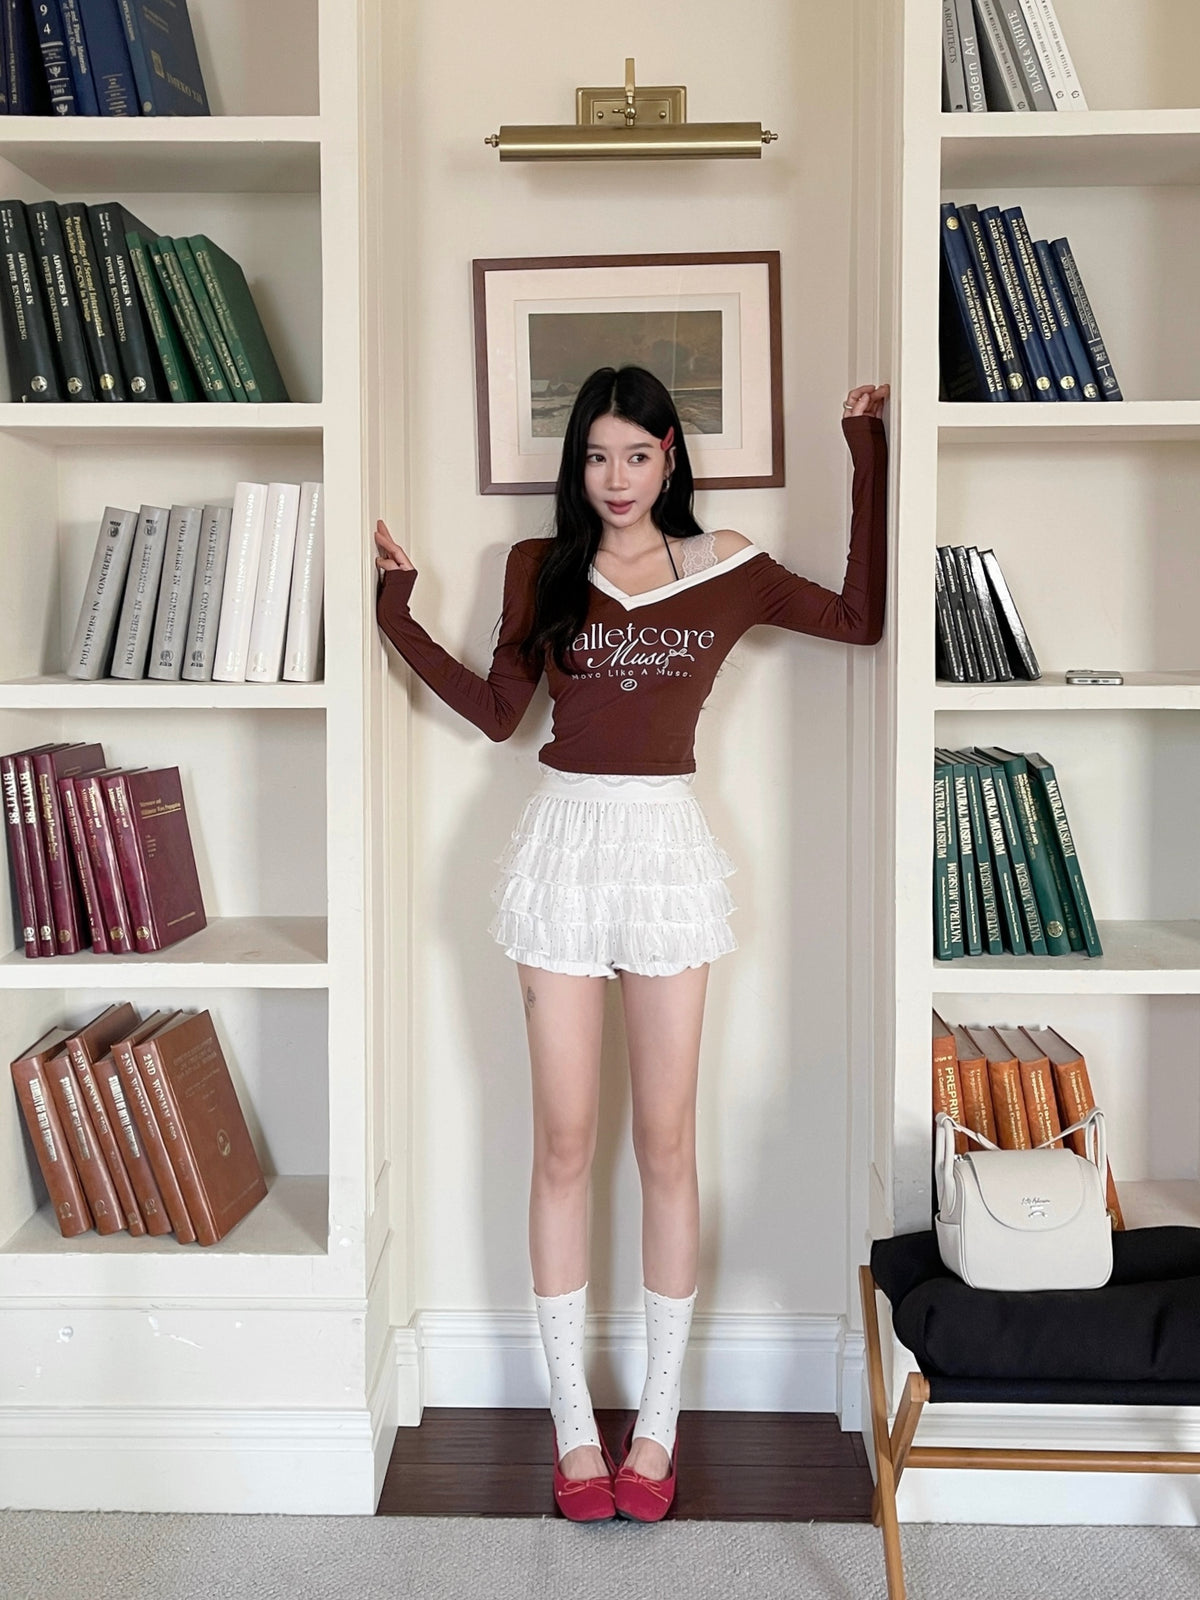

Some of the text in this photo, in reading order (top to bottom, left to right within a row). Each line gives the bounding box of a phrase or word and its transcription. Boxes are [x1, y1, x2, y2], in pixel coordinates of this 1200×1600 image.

[40, 4, 48, 16] 9
[43, 23, 51, 35] 4
[942, 6, 959, 64] ARCHITECTS
[963, 36, 983, 112] Modern Art
[1007, 10, 1043, 92] BLACK & WHITE
[6, 254, 17, 282] POWER
[12, 285, 27, 340] ENGINEERING
[18, 252, 33, 305] ADVANCES IN
[42, 256, 52, 284] POWER
[48, 287, 62, 342] ENGINEERING
[53, 254, 69, 307] ADVANCES IN
[65, 217, 91, 322] Workshop on CSCW in Design
[73, 216, 104, 337] Proceedings of Second International
[105, 256, 126, 342] POWER ENGINEERING
[116, 255, 132, 307] ADVANCES IN
[961, 275, 968, 283] IN
[972, 221, 987, 262] ADVANCES
[982, 262, 990, 271] IN
[986, 272, 1005, 326] MANAGEMENT
[1001, 327, 1014, 360] SCIENCE
[989, 219, 999, 240] FLUID
[995, 240, 1006, 265] POWER
[1002, 265, 1019, 310] ENGINEERING
[1011, 220, 1022, 240] FLUID
[1017, 240, 1029, 265] POWER
[1024, 265, 1042, 310] ENGINEERING
[970, 308, 978, 323] AND
[974, 298, 991, 344] ENGINEERING
[1016, 286, 1024, 300] AND
[1027, 325, 1033, 333] IN
[1038, 286, 1047, 300] AND
[1050, 324, 1057, 332] IN
[1052, 287, 1070, 327] LEARNING
[987, 344, 998, 369] POWER
[993, 369, 1003, 390] FLUID
[80, 545, 114, 665] POLYMERS IN CONCRETE
[125, 544, 152, 665] POLYMERS IN CONCRETE
[164, 520, 187, 642] POLYMERS IN CONCRETE
[196, 520, 218, 642] POLYMERS IN CONCRETE
[572, 622, 715, 651] alletcore
[608, 669, 634, 678] Like
[934, 780, 947, 858] NATURAL MUSEUM
[955, 777, 972, 855] NATURAL MUSEUM
[982, 778, 1005, 855] NATURAL MUSEUM
[1046, 780, 1075, 857] NATURAL MUSEUM
[947, 863, 961, 942] NATURAL MUSEUM
[979, 862, 1000, 941] NATURAL MUSEUM
[1015, 863, 1042, 942] NATURAL MUSEUM
[73, 1050, 87, 1071] 2ND
[121, 1053, 134, 1074] 2ND
[143, 1054, 156, 1075] 2ND
